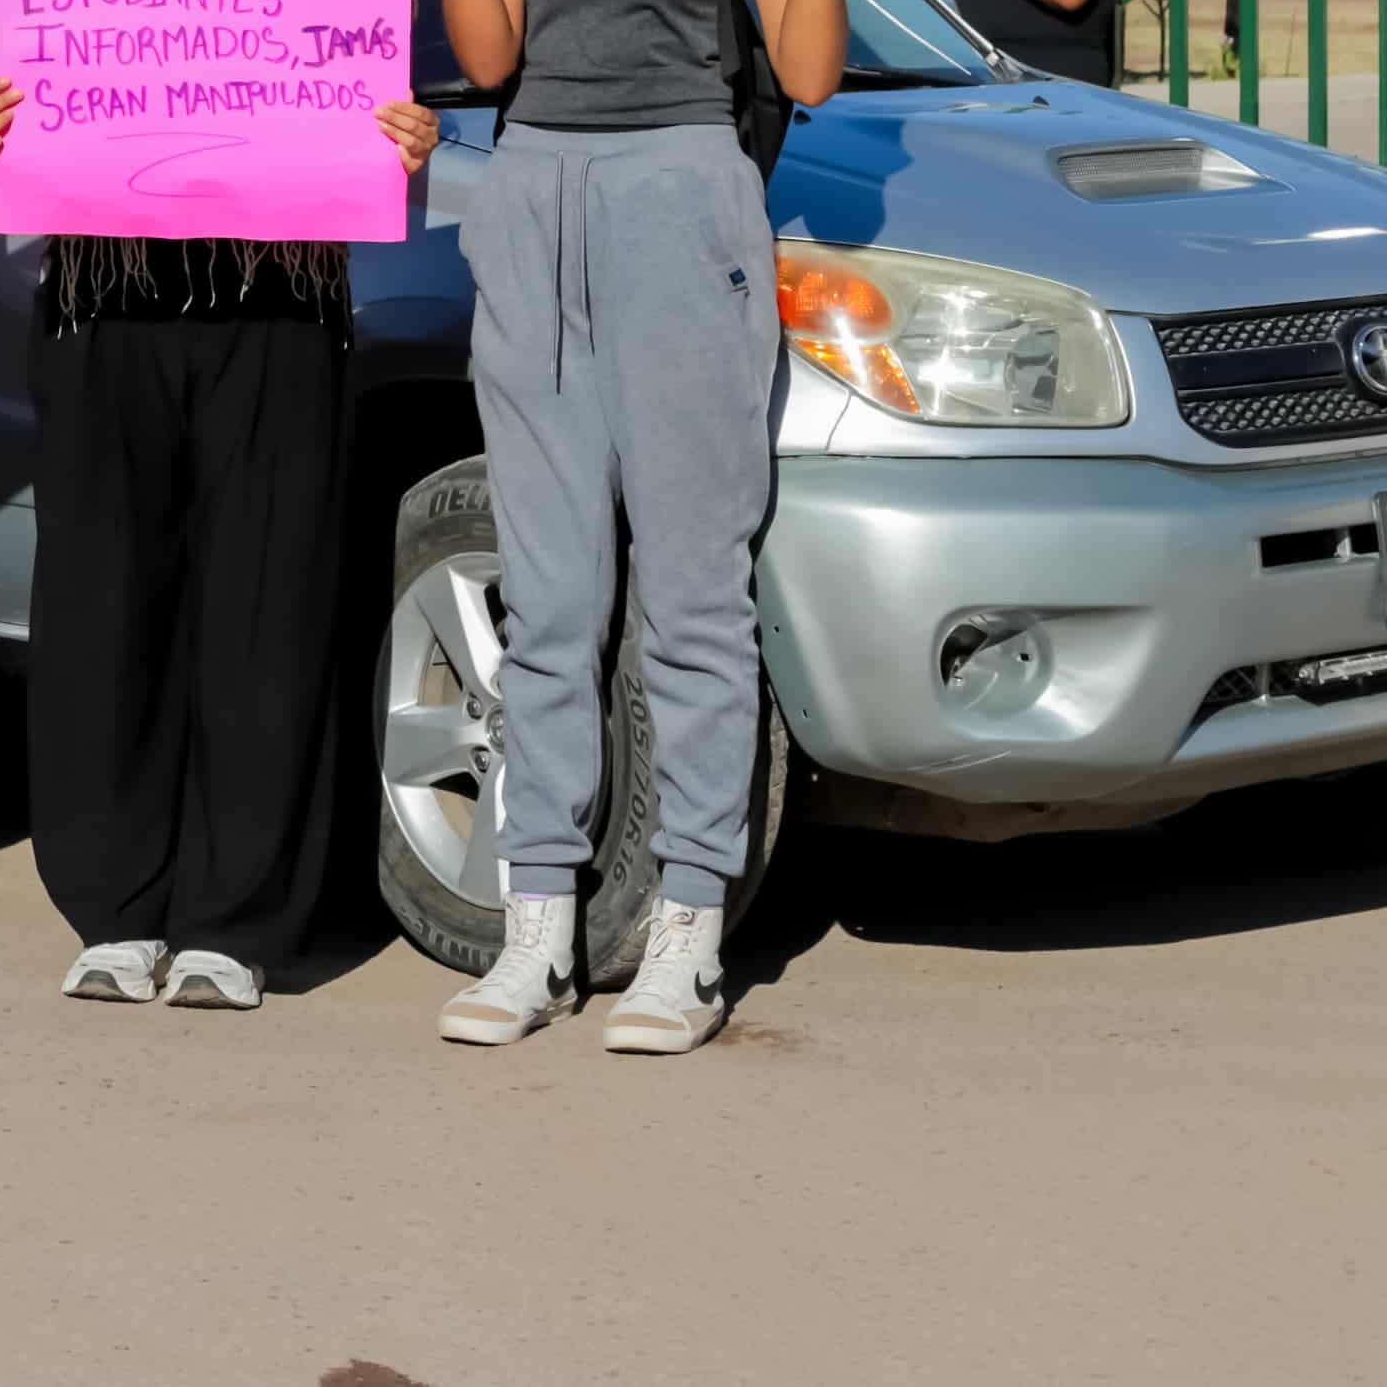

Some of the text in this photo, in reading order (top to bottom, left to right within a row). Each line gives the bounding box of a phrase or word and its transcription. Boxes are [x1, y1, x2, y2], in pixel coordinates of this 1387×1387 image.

[14, 16, 398, 71] INFORMADOS, JAMÁS
[34, 77, 374, 132] SERAN MANIPULADOS
[613, 669, 652, 888] 205/70R16
